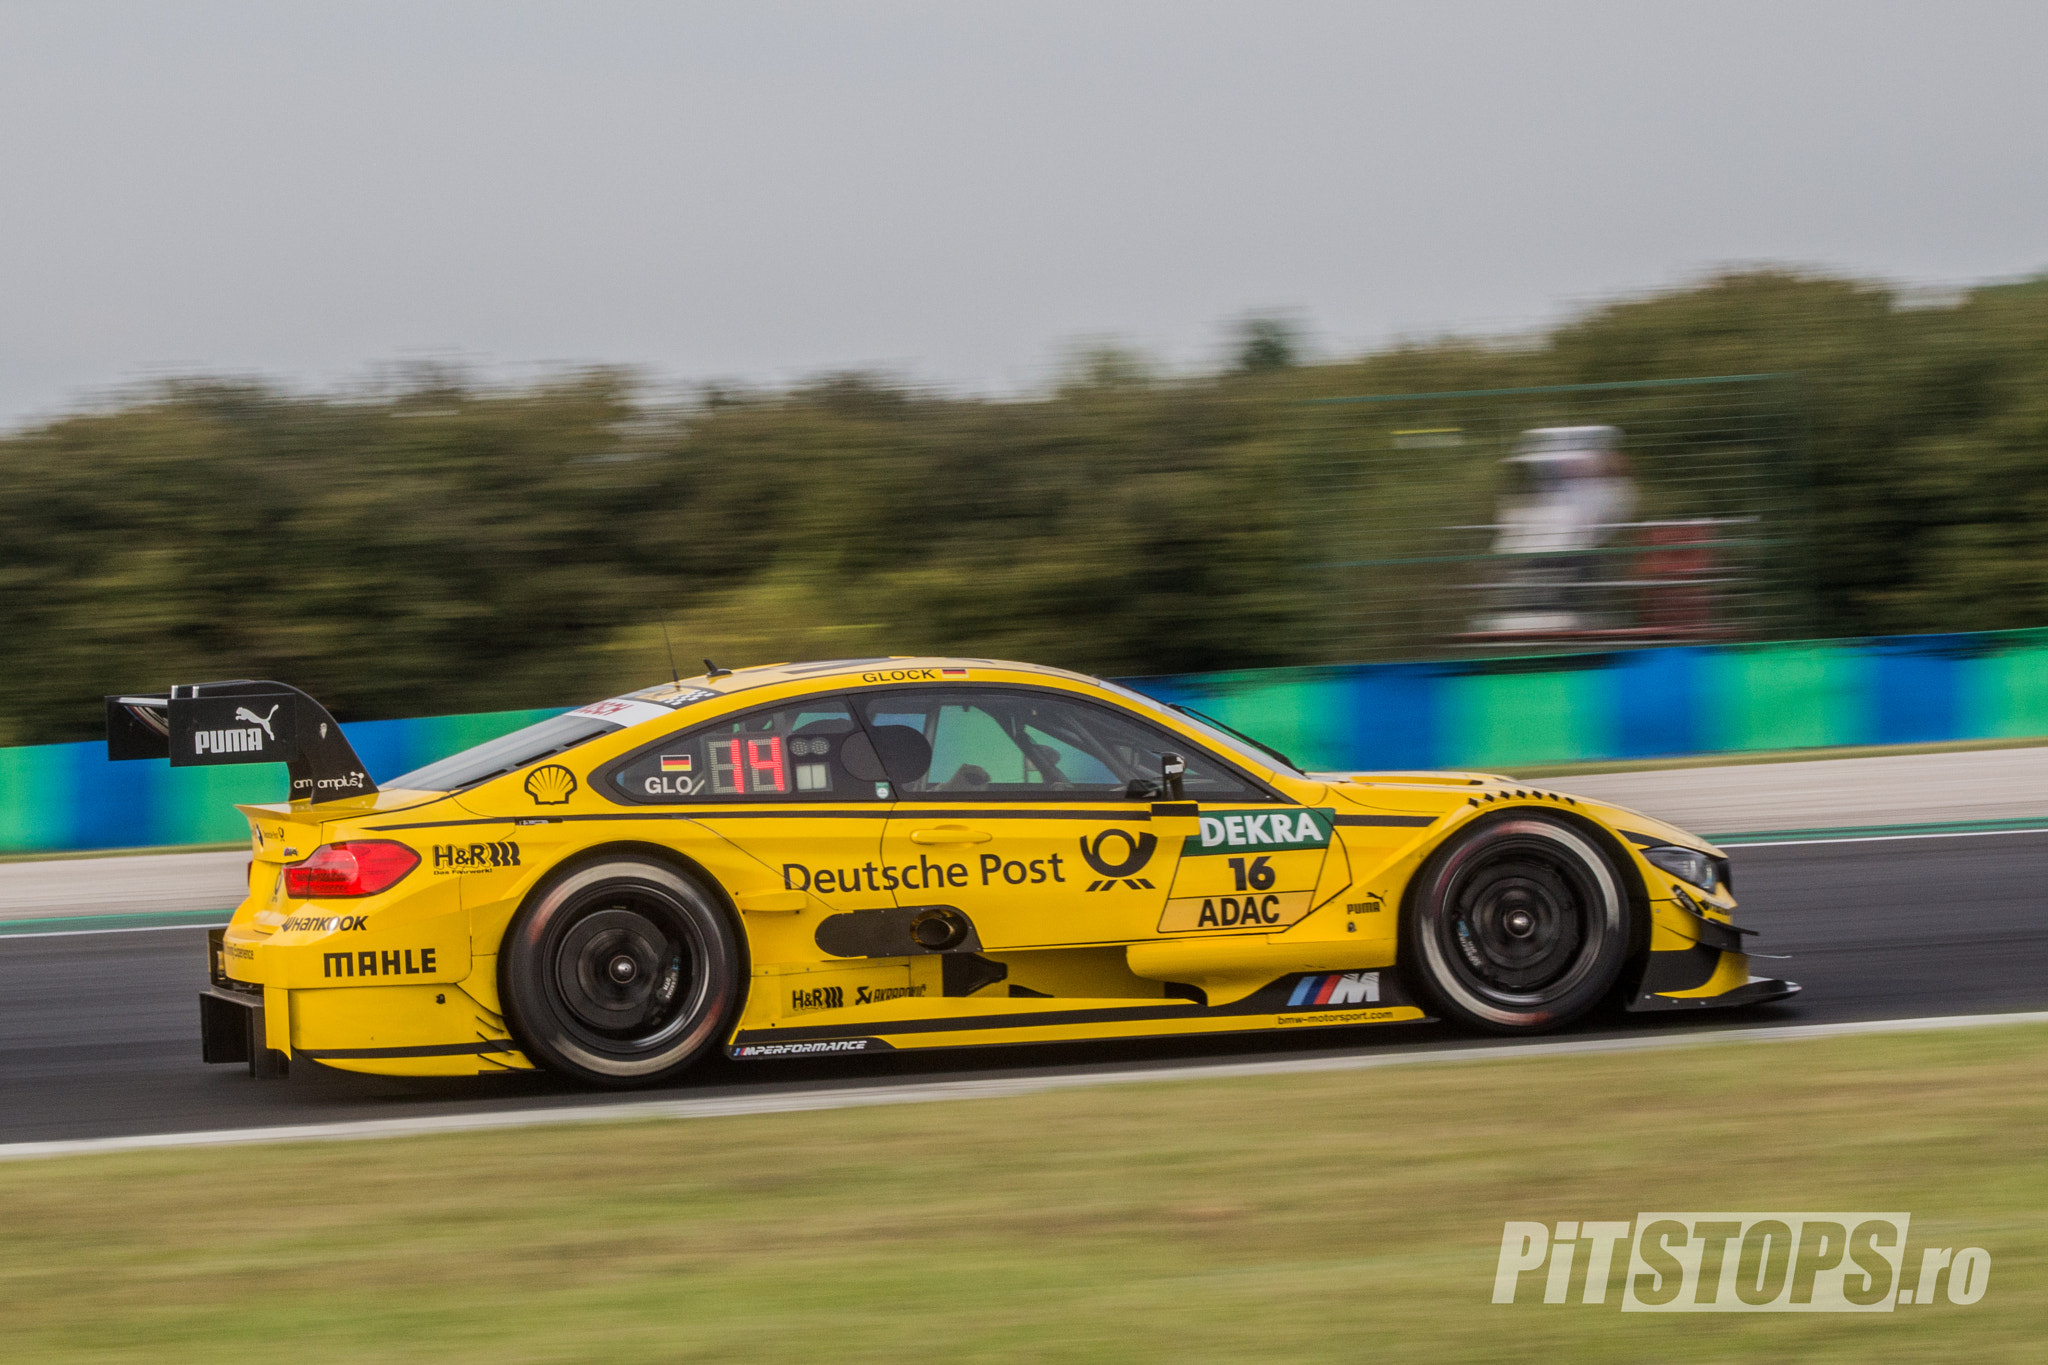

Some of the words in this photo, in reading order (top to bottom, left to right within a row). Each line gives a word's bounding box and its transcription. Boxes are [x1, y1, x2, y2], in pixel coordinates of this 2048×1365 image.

[862, 669, 936, 683] GLOCK
[195, 728, 263, 755] PUMA
[730, 736, 785, 794] 14
[317, 775, 359, 791] amplus
[1200, 813, 1324, 847] DEKRA
[433, 844, 489, 869] H&R
[783, 854, 969, 894] Deutsche
[981, 852, 1066, 886] Post
[1228, 856, 1276, 892] 16
[1198, 895, 1280, 928] ADAC
[1347, 902, 1380, 915] PUMA
[324, 948, 437, 978] MAHLE
[792, 988, 823, 1010] H&R
[1277, 1011, 1394, 1025] bmw-motorsport.com
